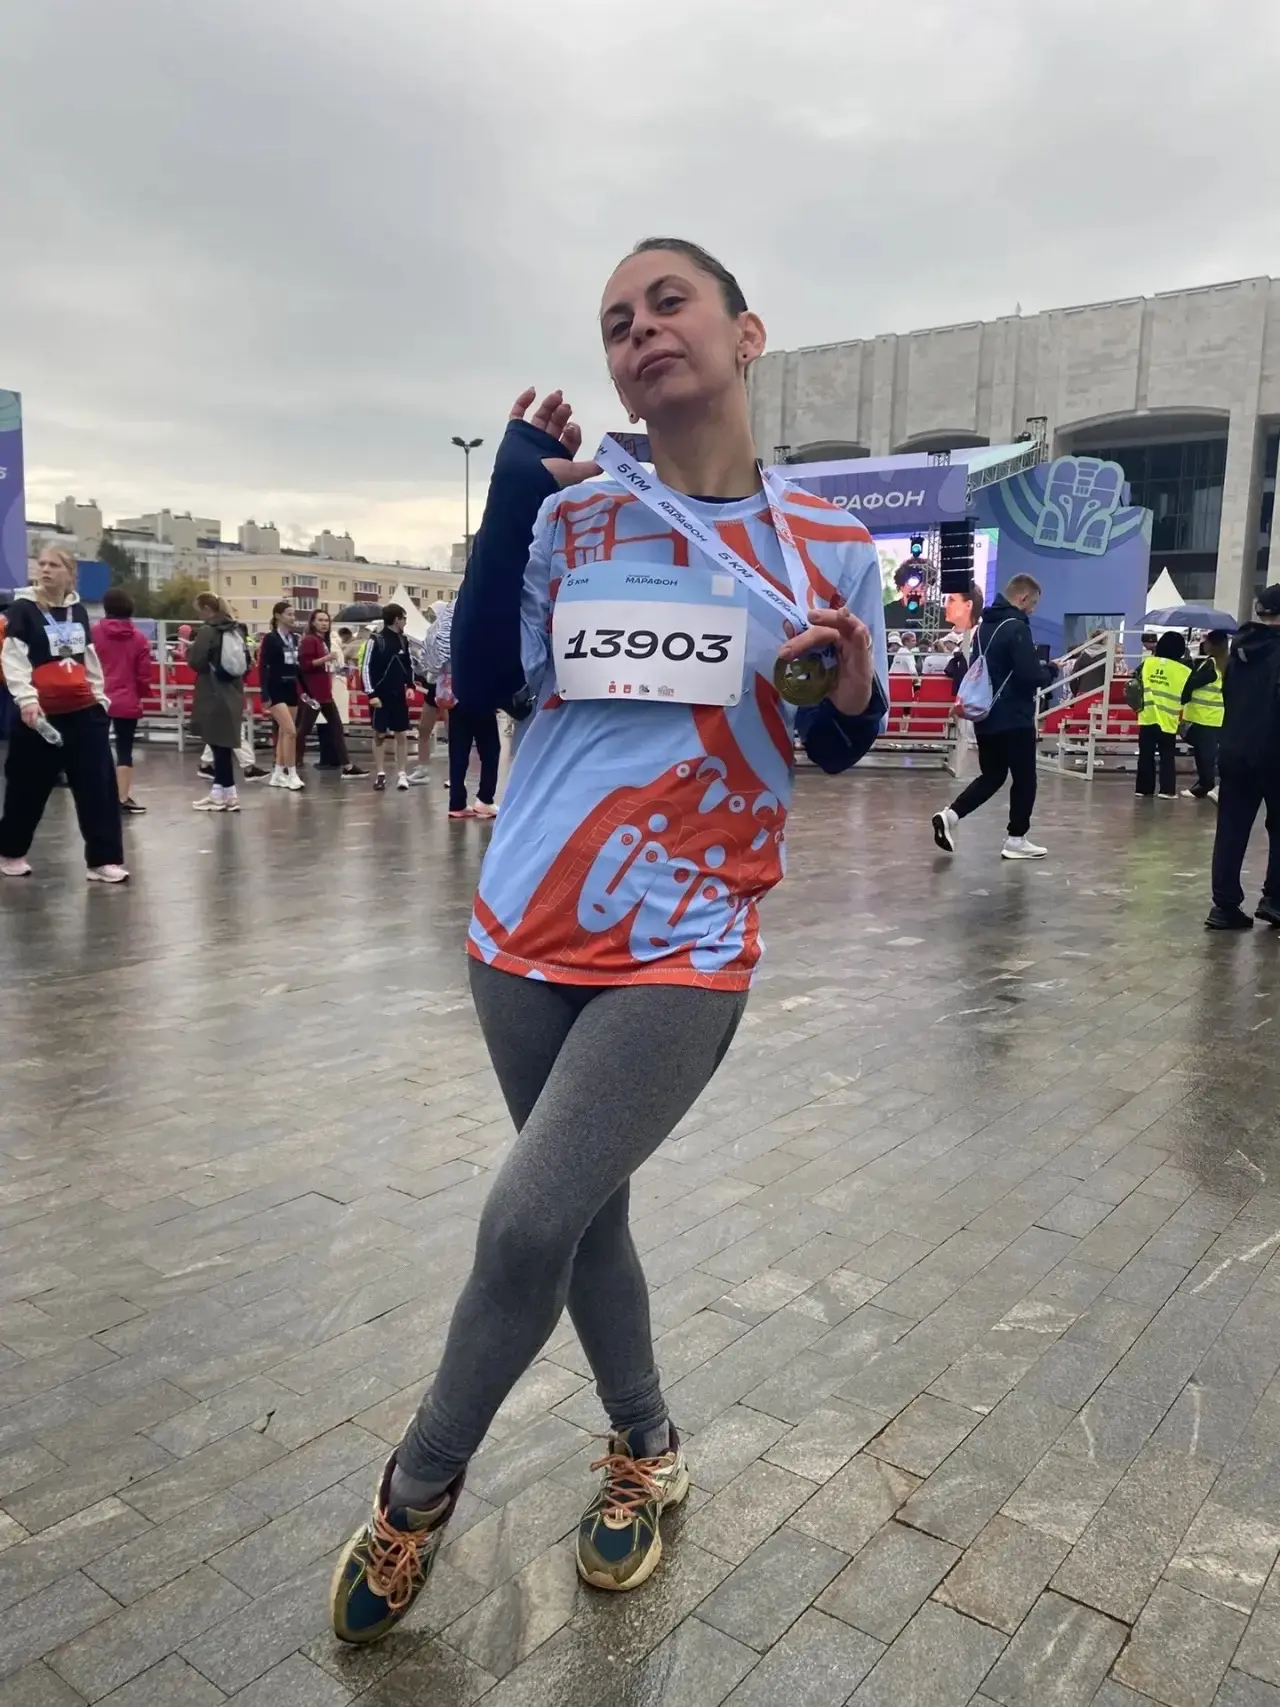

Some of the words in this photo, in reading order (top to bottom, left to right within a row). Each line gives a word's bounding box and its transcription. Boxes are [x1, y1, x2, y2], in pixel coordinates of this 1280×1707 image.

[617, 463, 631, 473] 5
[821, 489, 926, 511] РАФОН
[657, 501, 708, 542] МАРАФОН
[717, 552, 728, 561] 5
[567, 578, 575, 587] 5
[625, 576, 679, 587] МАРАФОН
[563, 629, 733, 664] 13903
